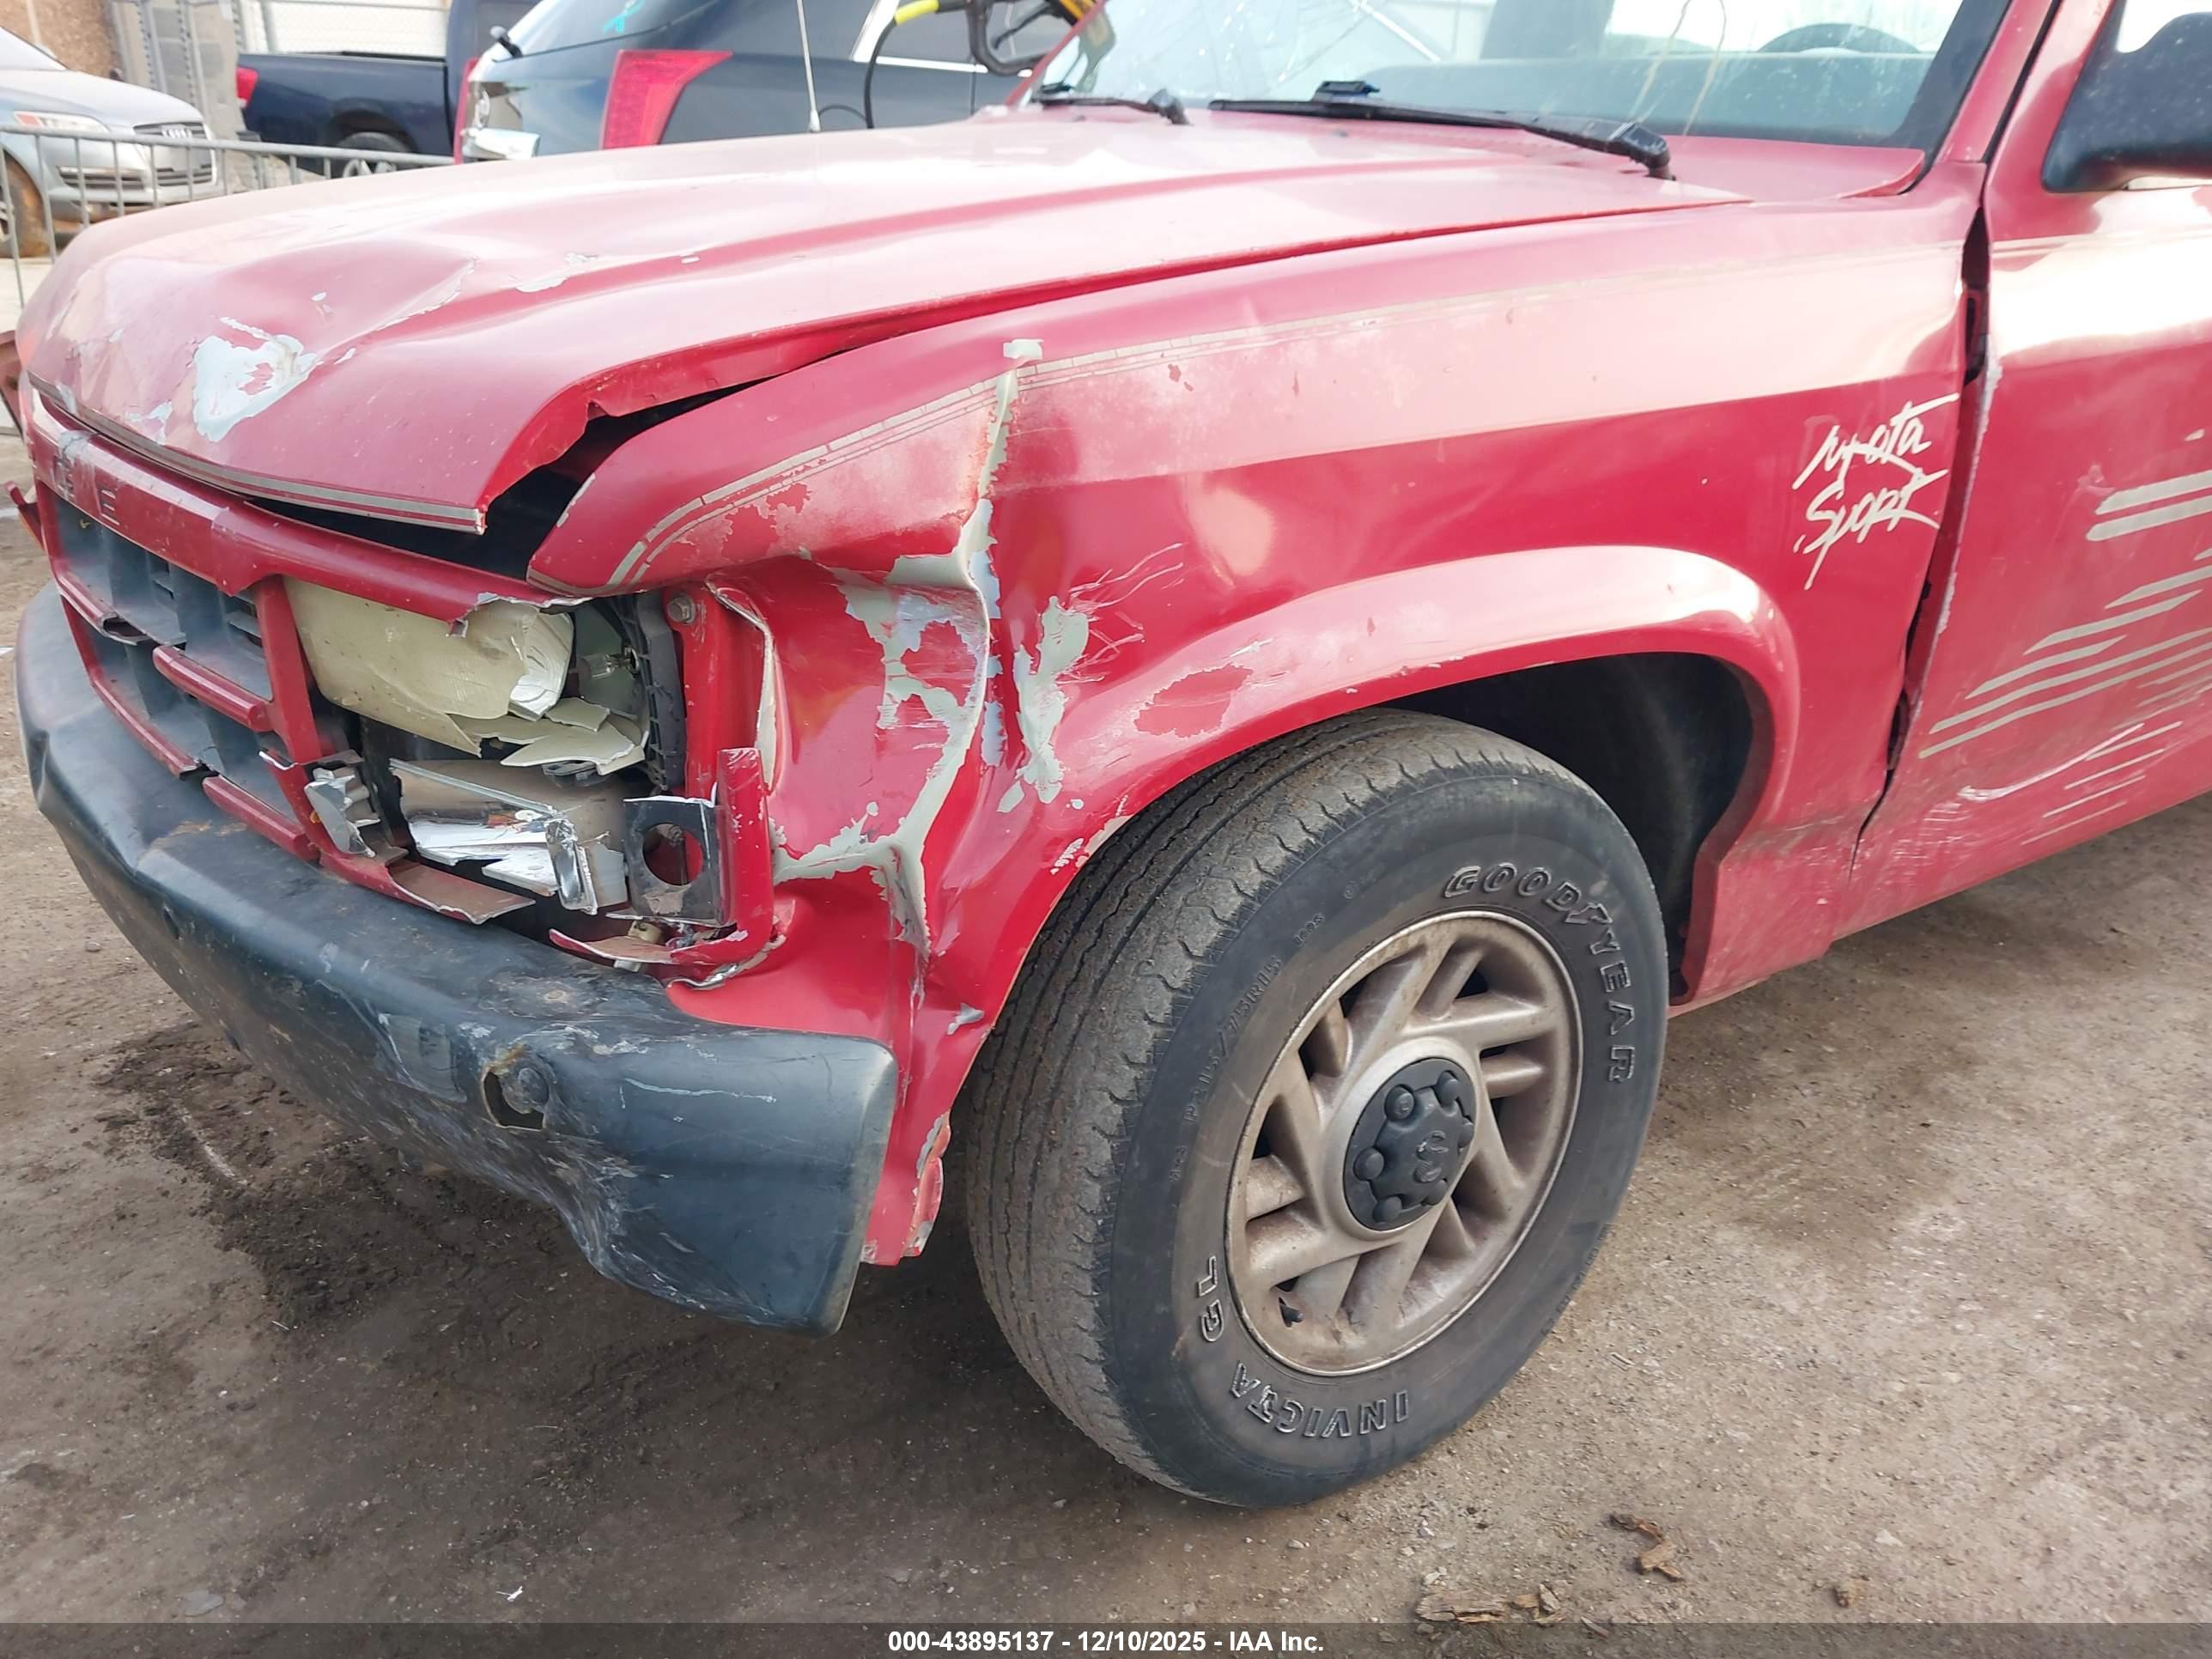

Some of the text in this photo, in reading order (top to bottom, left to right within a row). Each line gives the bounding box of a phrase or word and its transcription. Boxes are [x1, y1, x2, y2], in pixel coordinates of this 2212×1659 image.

[1443, 861, 1636, 1083] GOODYEAR
[1197, 1255, 1409, 1438] INVICTA GL
